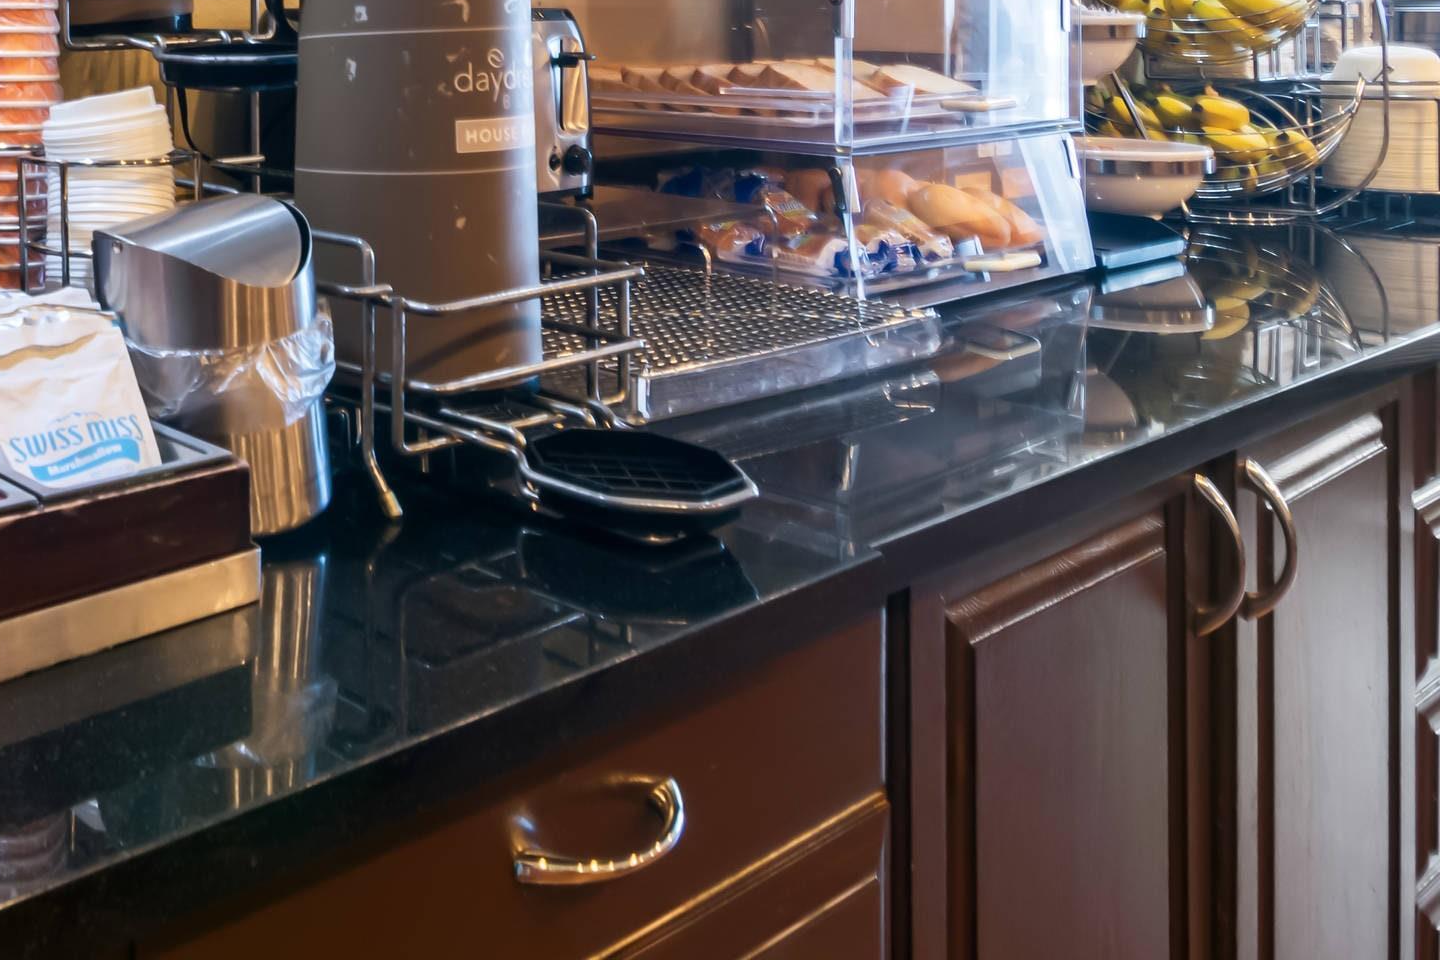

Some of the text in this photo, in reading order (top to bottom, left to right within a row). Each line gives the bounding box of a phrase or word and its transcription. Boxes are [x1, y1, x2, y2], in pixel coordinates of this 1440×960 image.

[465, 127, 518, 144] HOUSE
[10, 413, 145, 463] SWISS MISS
